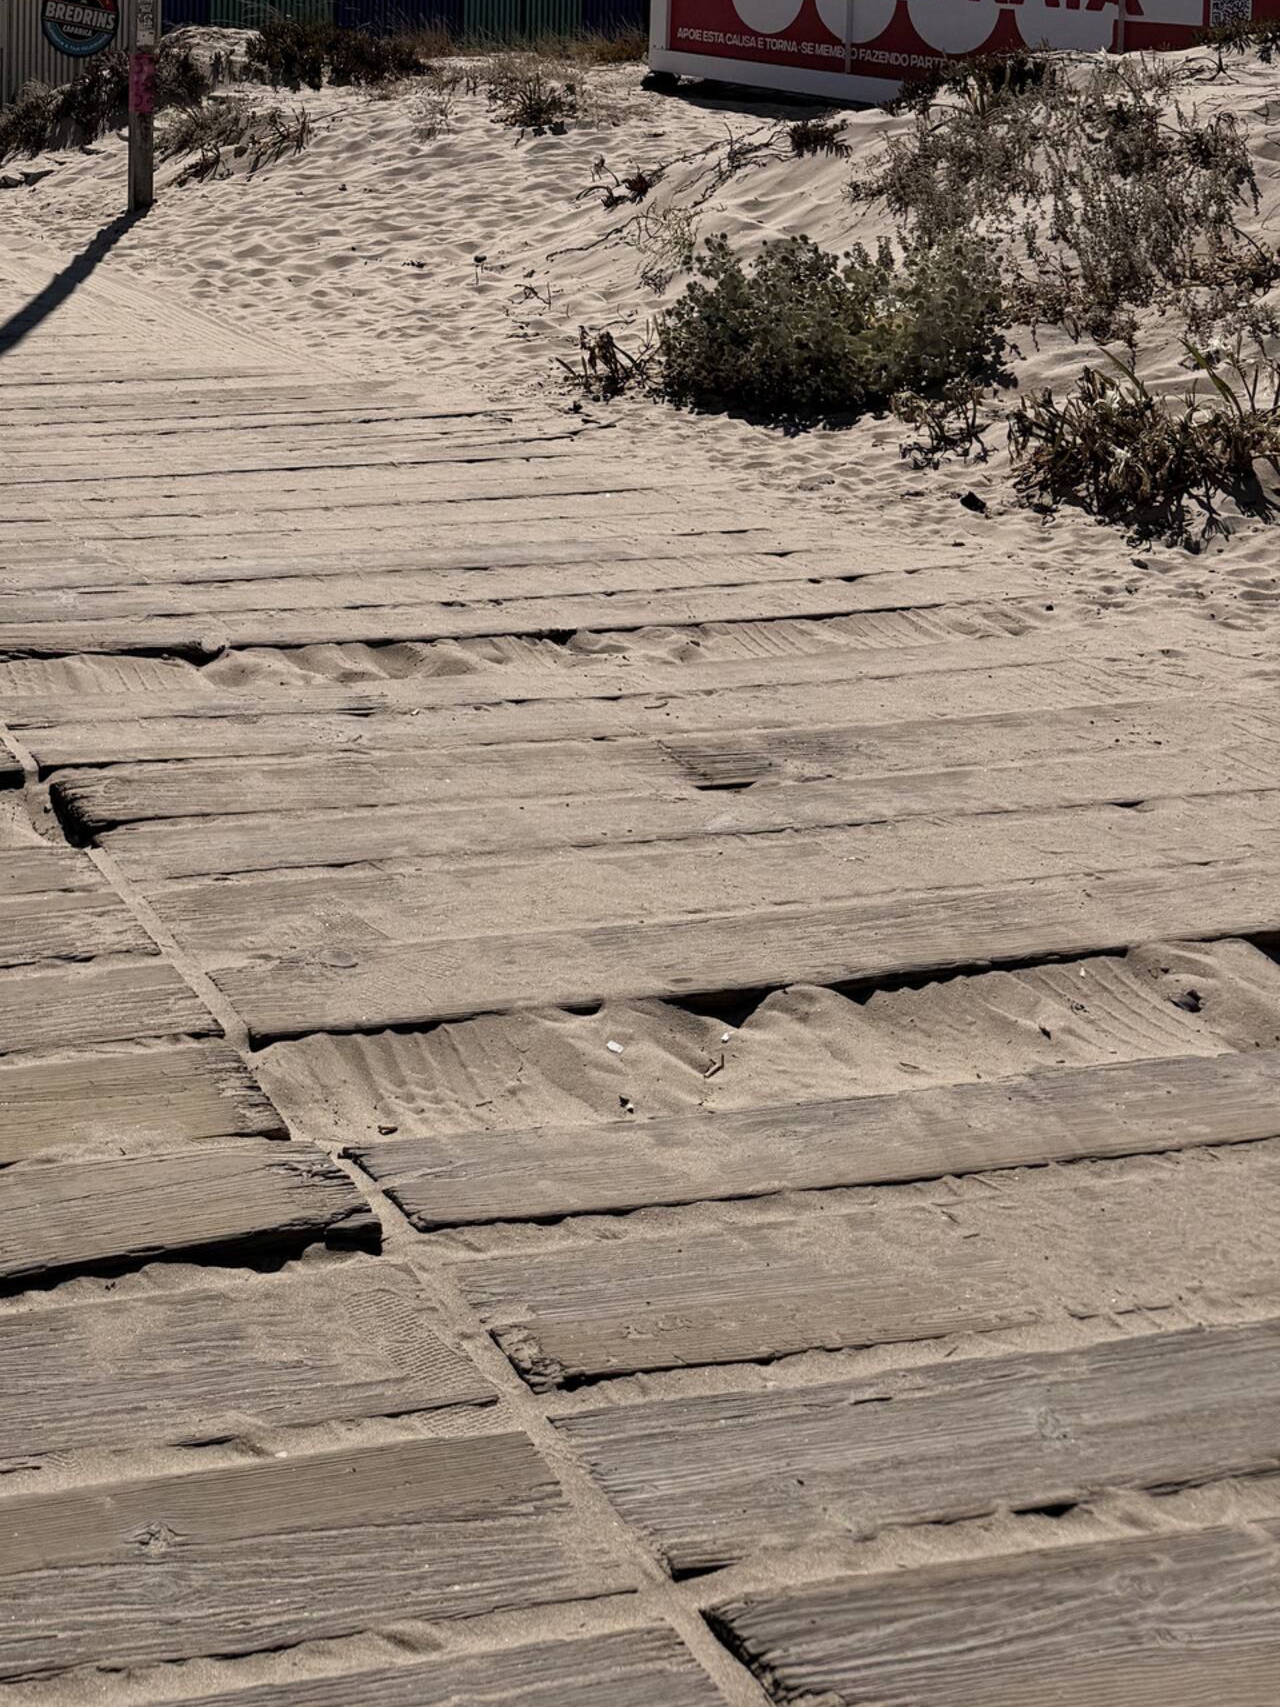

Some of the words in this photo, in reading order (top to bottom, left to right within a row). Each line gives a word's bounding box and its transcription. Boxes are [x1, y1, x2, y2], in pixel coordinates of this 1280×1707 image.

[45, 1, 116, 30] BREDRINS
[703, 30, 725, 45] ESTA
[725, 33, 757, 48] CAUSA
[757, 37, 765, 49] E
[858, 48, 910, 67] FAZENDO
